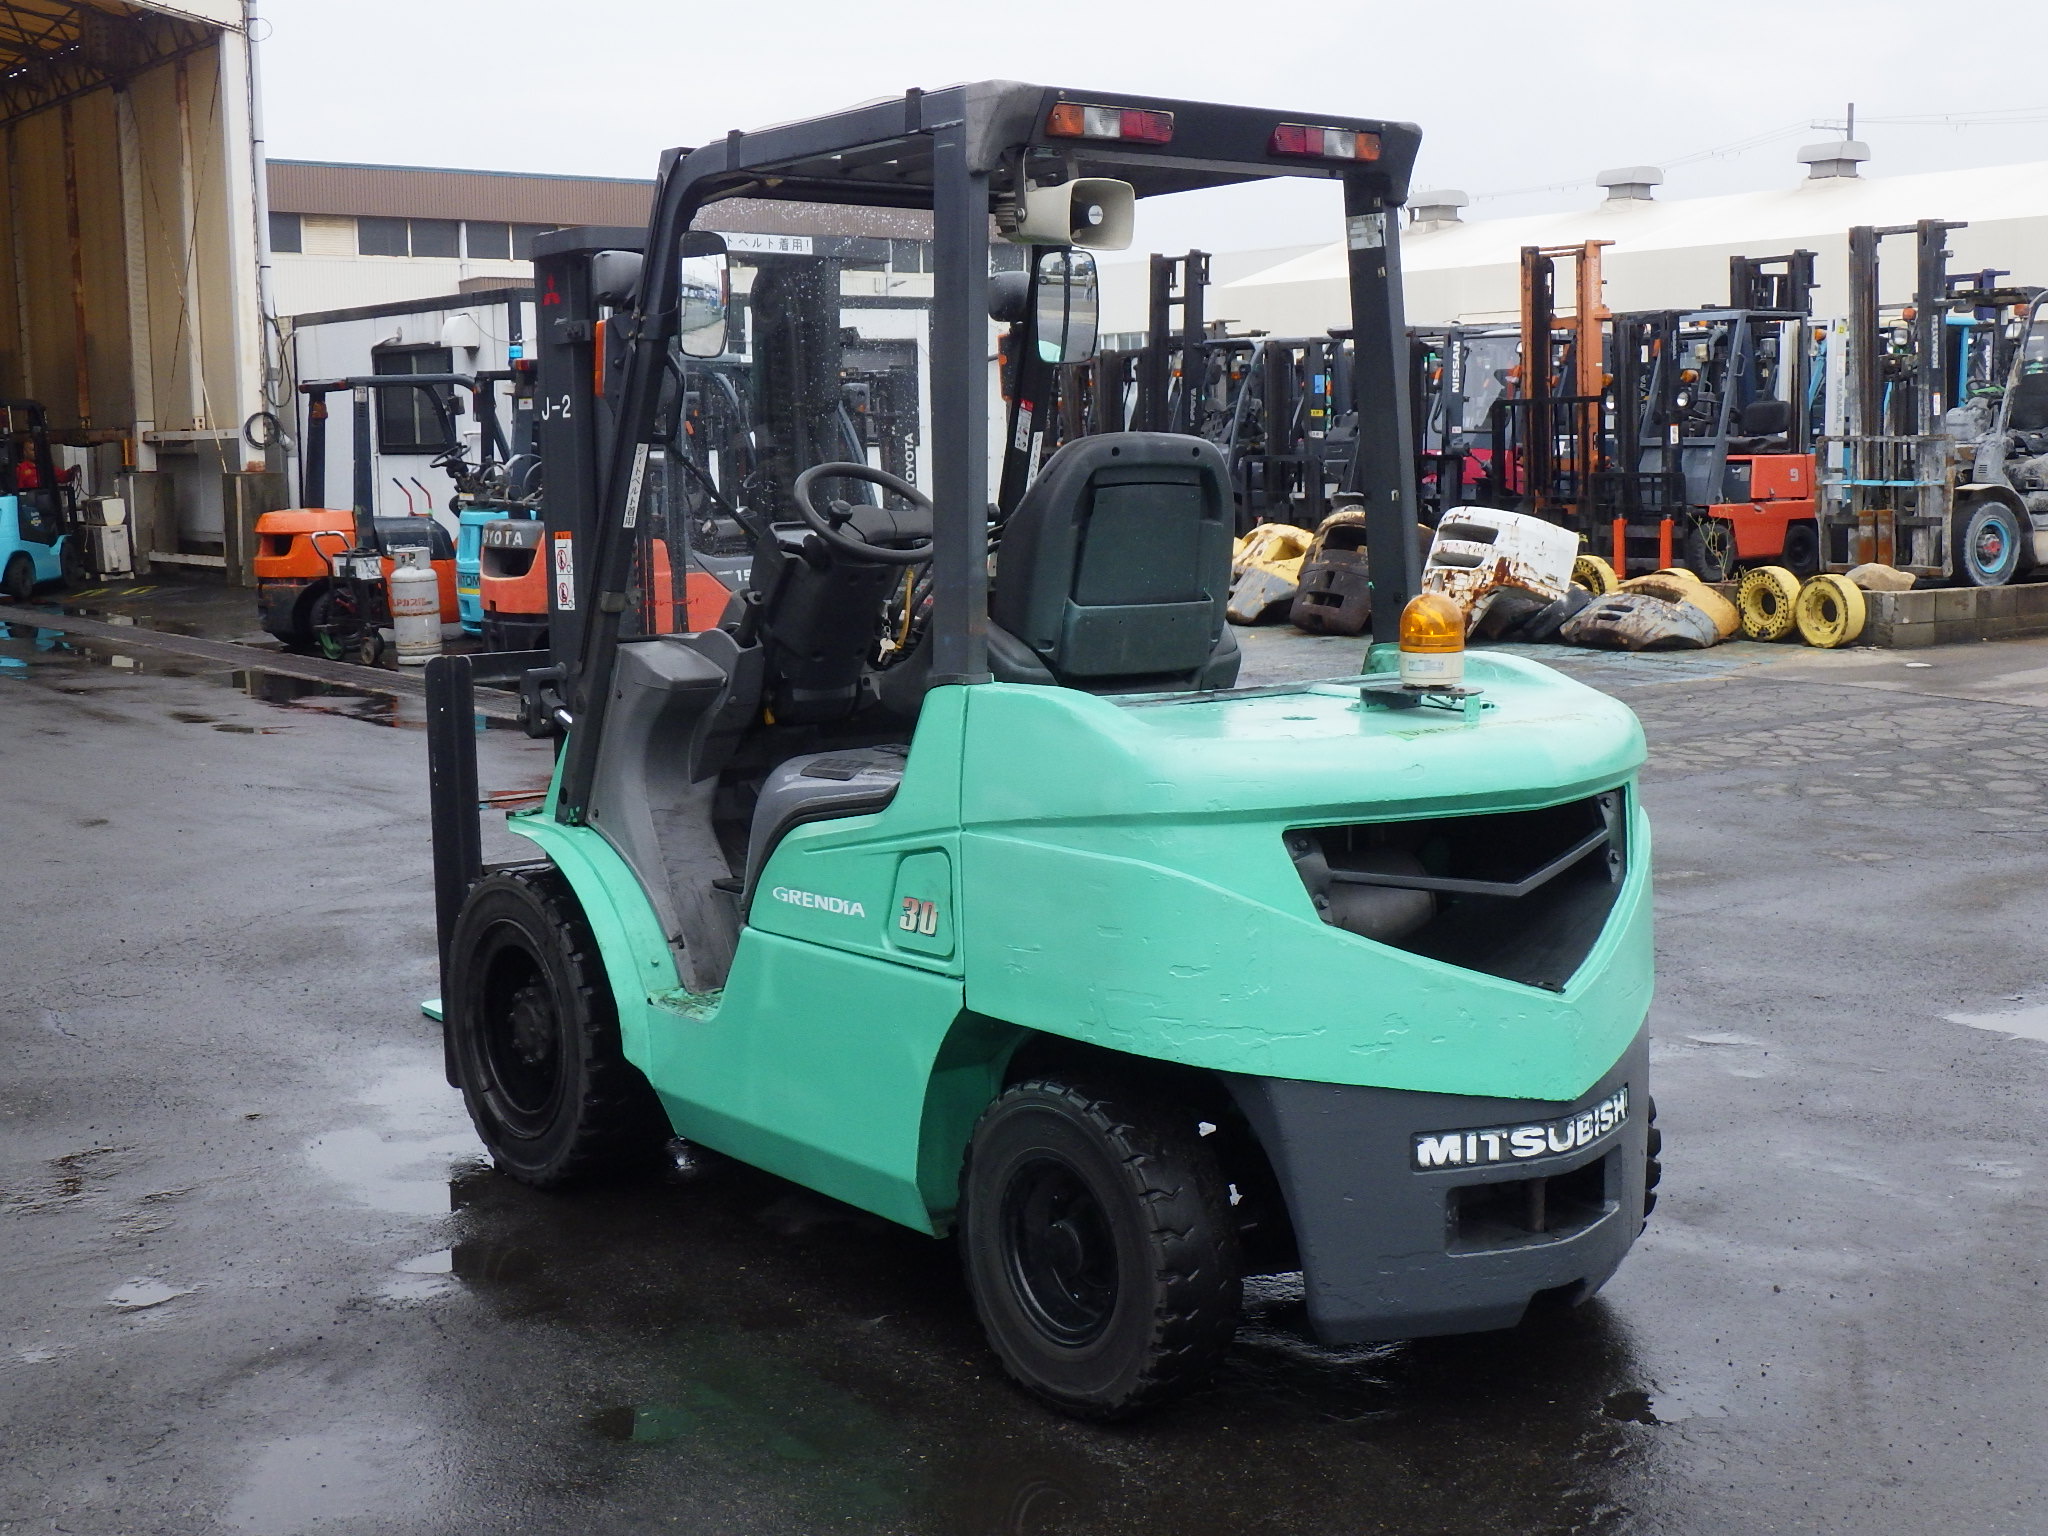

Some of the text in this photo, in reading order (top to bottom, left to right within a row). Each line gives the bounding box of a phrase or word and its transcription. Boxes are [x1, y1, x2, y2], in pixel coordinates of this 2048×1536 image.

[1931, 315, 1939, 369] KOMATSU
[1452, 341, 1460, 393] NISSAN
[541, 394, 572, 421] J-2
[1790, 468, 1799, 482] 9
[899, 896, 939, 938] 30
[1416, 1087, 1629, 1168] MITSUBISHI
